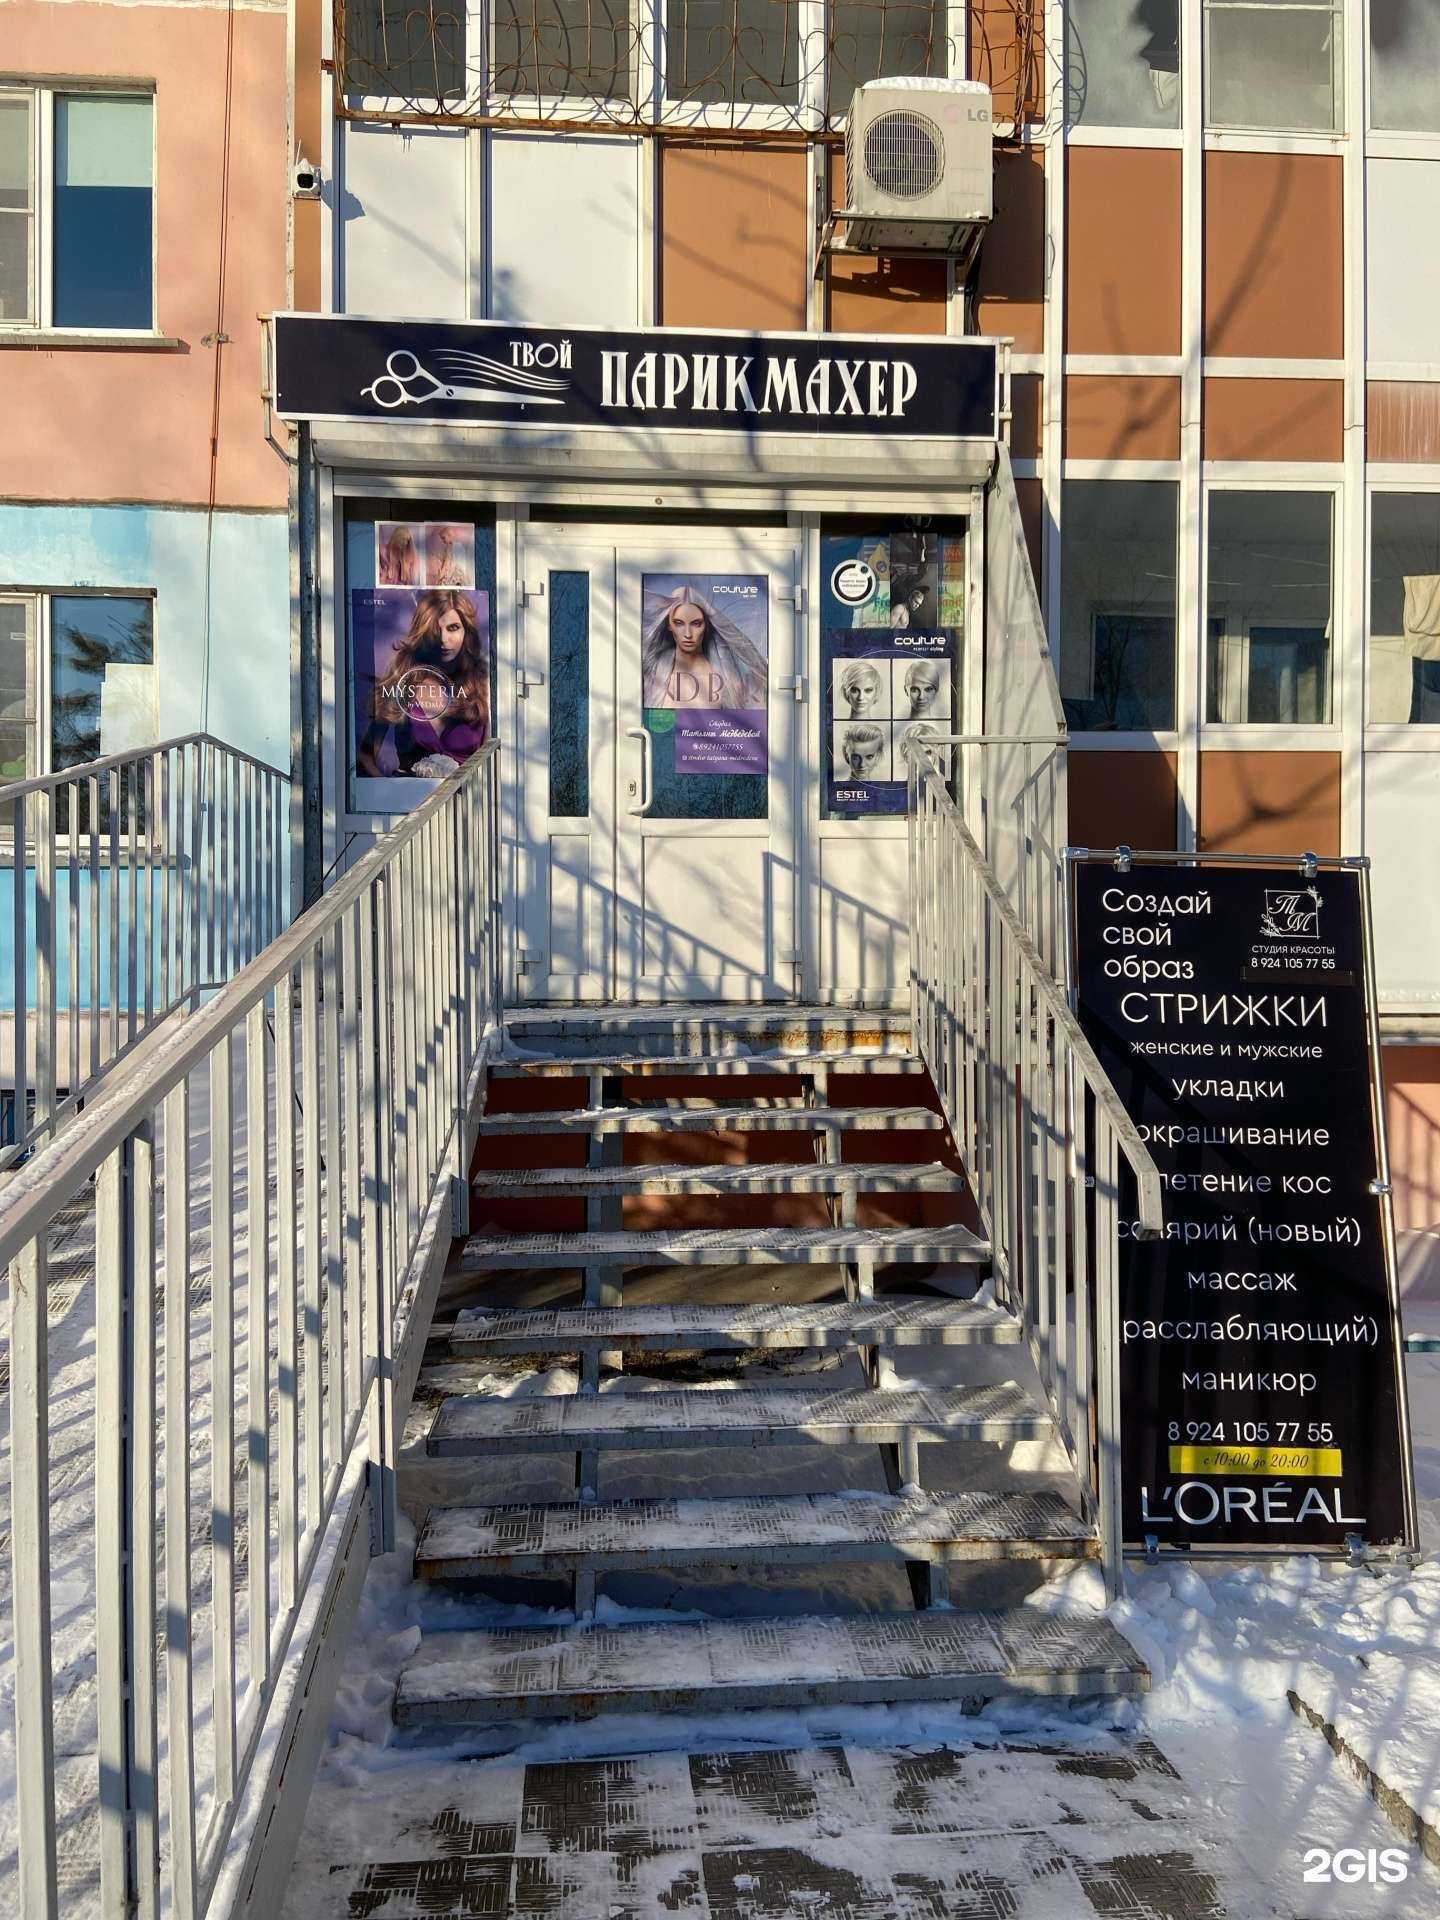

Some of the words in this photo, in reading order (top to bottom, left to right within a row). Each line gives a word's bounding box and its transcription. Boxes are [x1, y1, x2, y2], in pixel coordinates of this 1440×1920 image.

[967, 109, 989, 122] LG
[509, 339, 573, 370] ТВОЙ
[600, 350, 919, 418] ПАРИКМАХЕР
[894, 636, 947, 645] couture
[381, 684, 468, 698] MYSTERIA
[836, 790, 870, 799] ESTEL
[1102, 888, 1212, 917] Создай
[1103, 922, 1172, 946] свой
[1251, 945, 1288, 954] СТУДИЯ
[1290, 946, 1335, 955] КРАСОТЫ
[1103, 953, 1195, 983] образ
[1251, 957, 1258, 968] 8
[1260, 957, 1281, 968] 924
[1284, 958, 1303, 969] 105
[1305, 958, 1319, 969] 77
[1321, 959, 1336, 969] 55
[1119, 991, 1328, 1027] СТРИЖКИ
[1130, 1040, 1214, 1056] женские
[1220, 1044, 1231, 1056] и
[1238, 1043, 1323, 1060] мужские
[1171, 1077, 1285, 1101] укладки
[1136, 1123, 1330, 1148] окрашивание
[1282, 1174, 1333, 1194] кос
[1116, 1214, 1238, 1246] соярий
[1248, 1215, 1362, 1247] (новый)
[1187, 1270, 1299, 1292] массаж
[1181, 1371, 1318, 1397] маникюр
[1168, 1422, 1180, 1441] 8
[1186, 1422, 1226, 1442] 924
[1232, 1422, 1270, 1442] 105
[1275, 1422, 1300, 1441] 77
[1307, 1423, 1334, 1443] 55
[1203, 1458, 1210, 1467] с
[1213, 1451, 1251, 1467] 10:00
[1252, 1458, 1266, 1471] до
[1270, 1453, 1310, 1469] 20:00
[1141, 1481, 1367, 1526] L'ORÉAL
